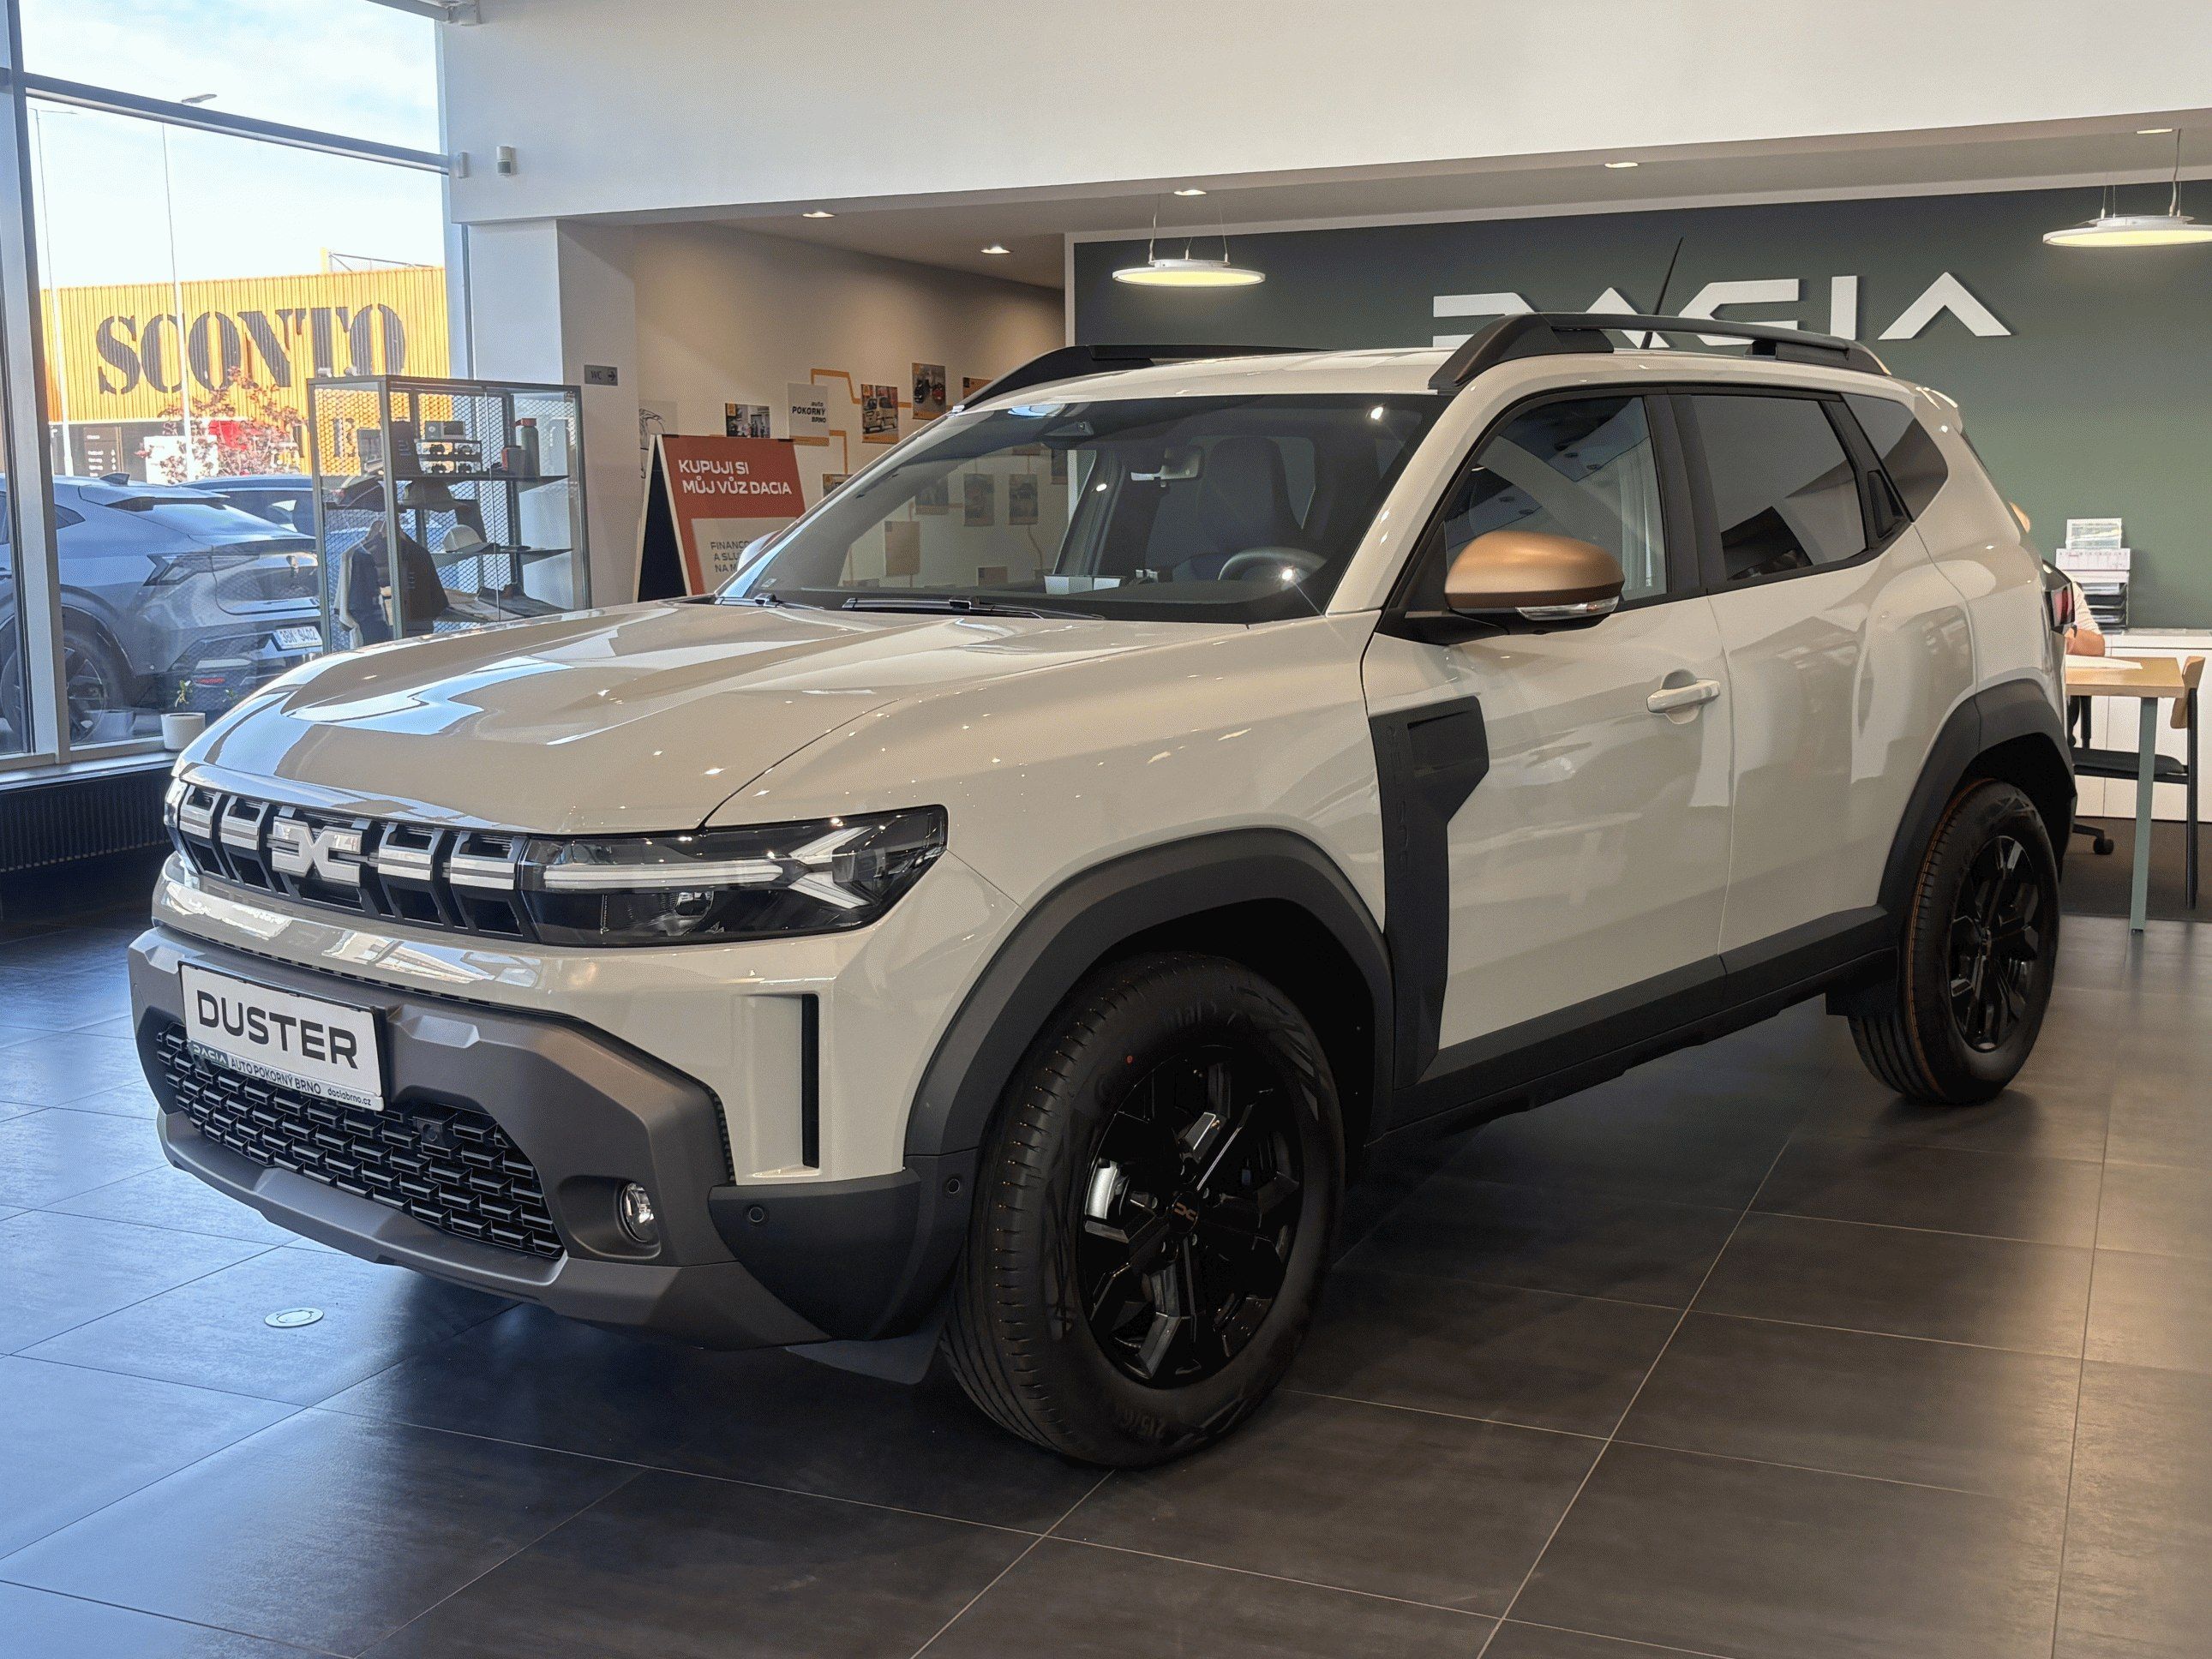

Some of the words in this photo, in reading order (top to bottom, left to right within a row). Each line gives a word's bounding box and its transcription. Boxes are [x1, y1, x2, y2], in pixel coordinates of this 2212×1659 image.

[96, 303, 406, 395] SCONTO
[590, 370, 602, 380] WC
[678, 459, 734, 475] KUPUJI
[735, 461, 750, 475] SI
[682, 475, 716, 494] MŮJ
[716, 476, 748, 494] VŮZ
[750, 481, 792, 494] DACIA
[714, 553, 721, 561] A
[715, 564, 728, 572] NA
[196, 989, 359, 1070] DUSTER
[193, 1044, 227, 1065] DACIA
[231, 1058, 253, 1075] AUTO
[255, 1068, 293, 1087] POKORNÝ
[295, 1077, 321, 1095] BRNO
[327, 1087, 372, 1106] daciabrno.cz
